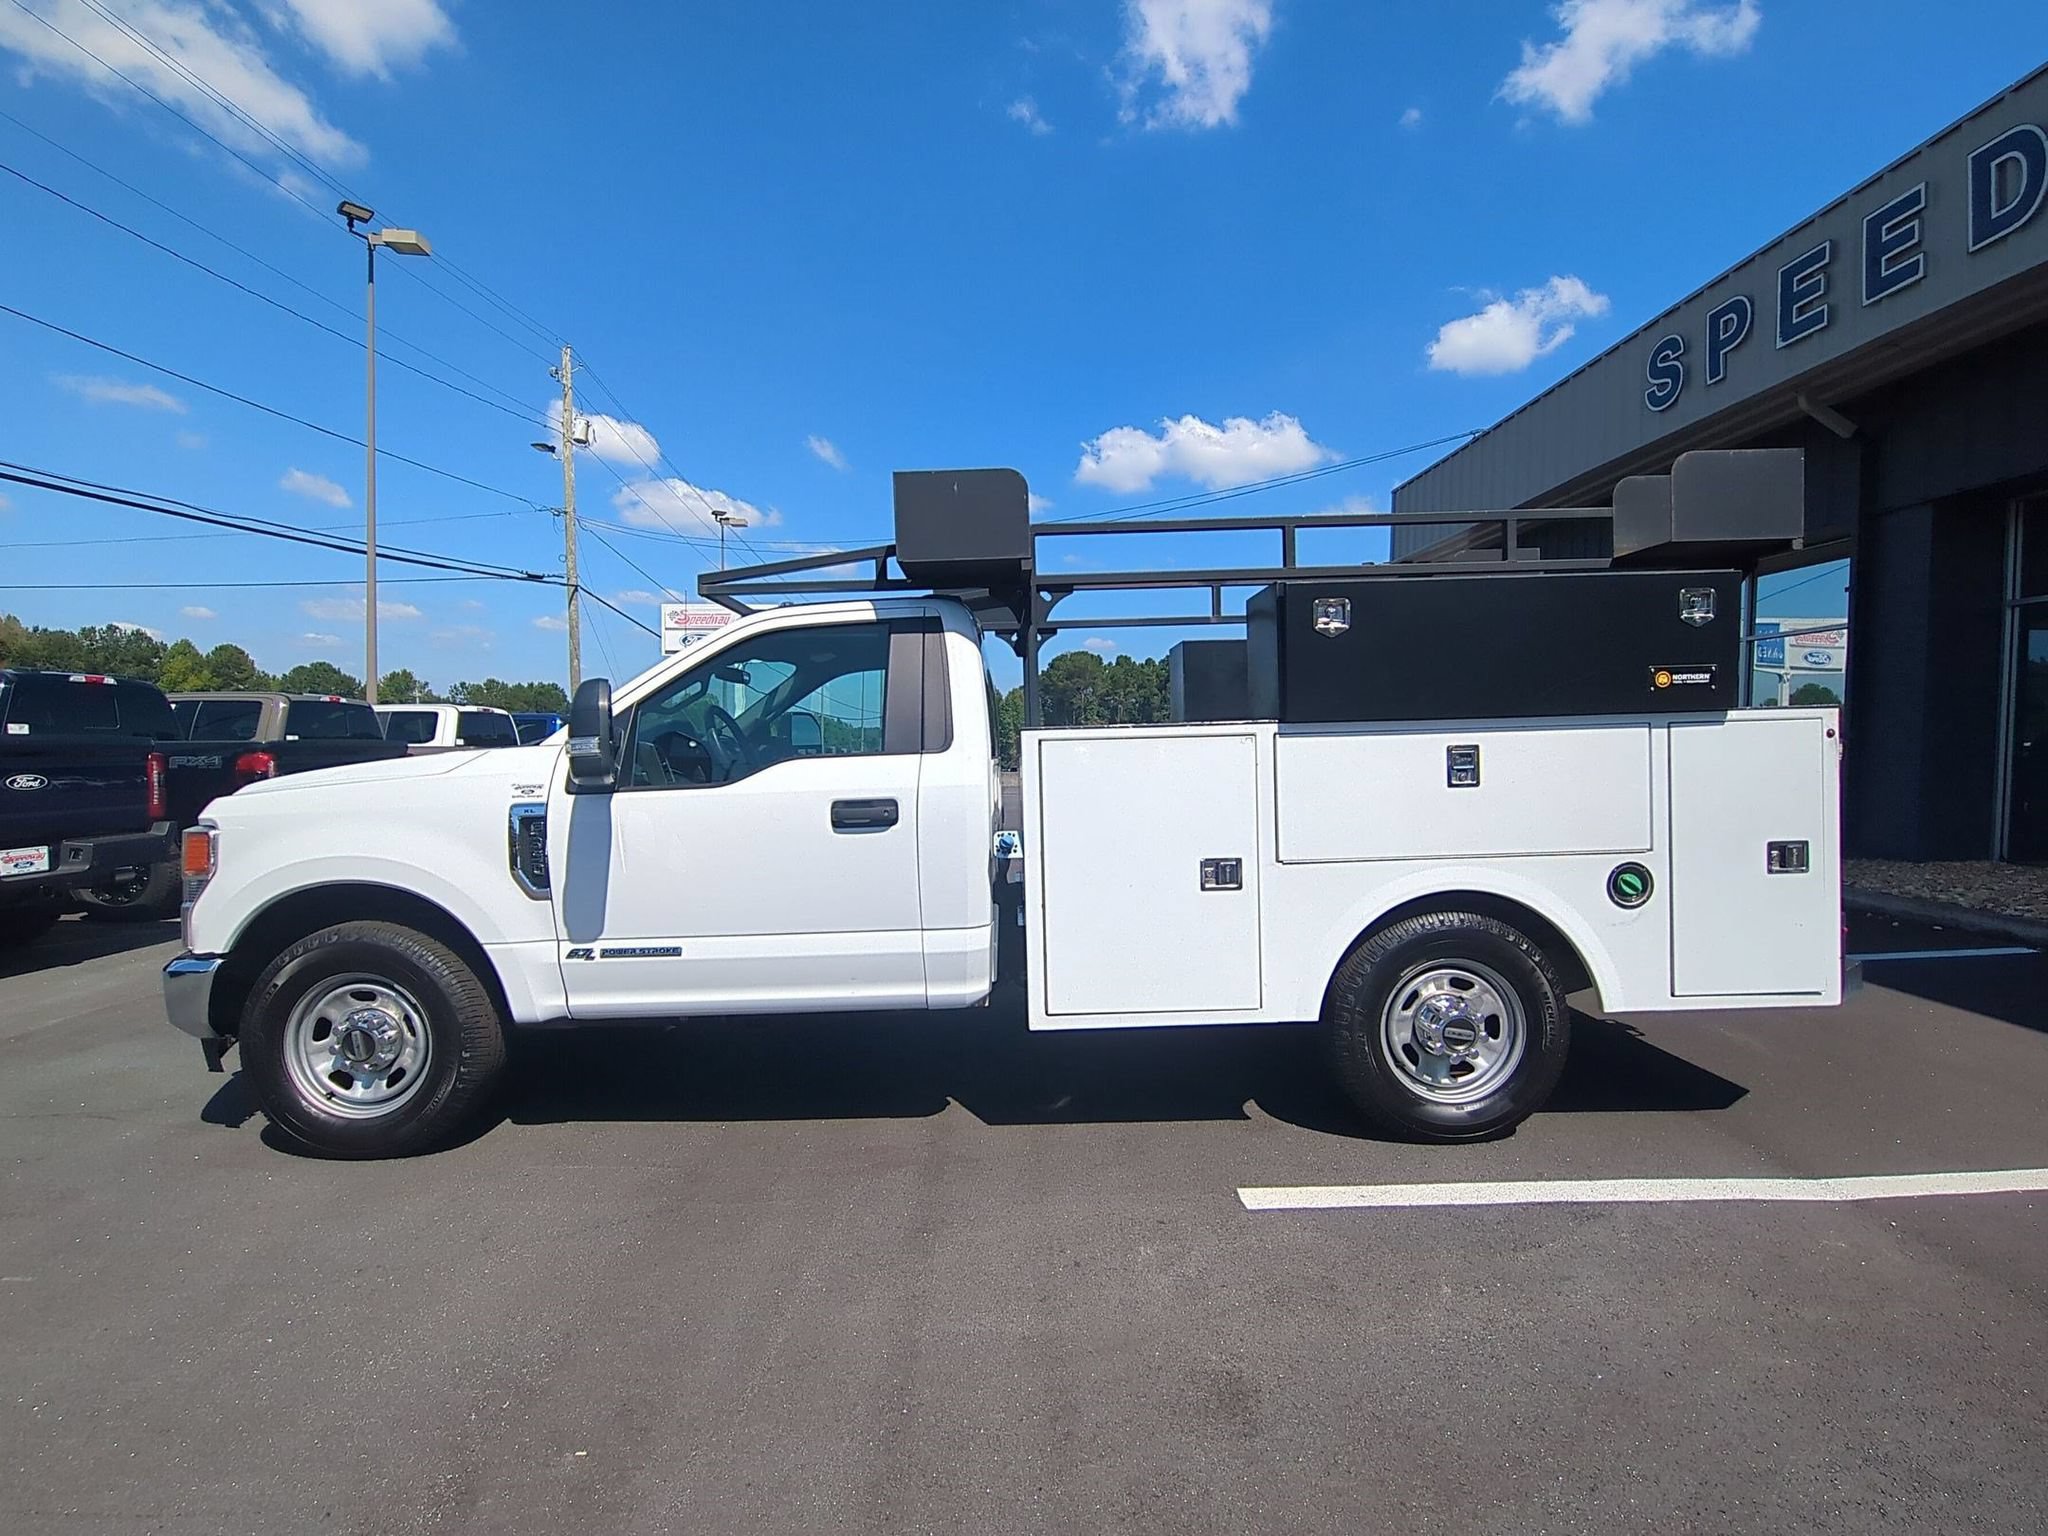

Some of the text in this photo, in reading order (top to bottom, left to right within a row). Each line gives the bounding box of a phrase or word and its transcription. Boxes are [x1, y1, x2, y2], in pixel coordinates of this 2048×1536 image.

[1645, 123, 2048, 412] SPEED
[674, 610, 732, 626] Speedway
[169, 756, 222, 769] FX4
[12, 776, 43, 788] Ford
[602, 947, 680, 957] POWER STROKE
